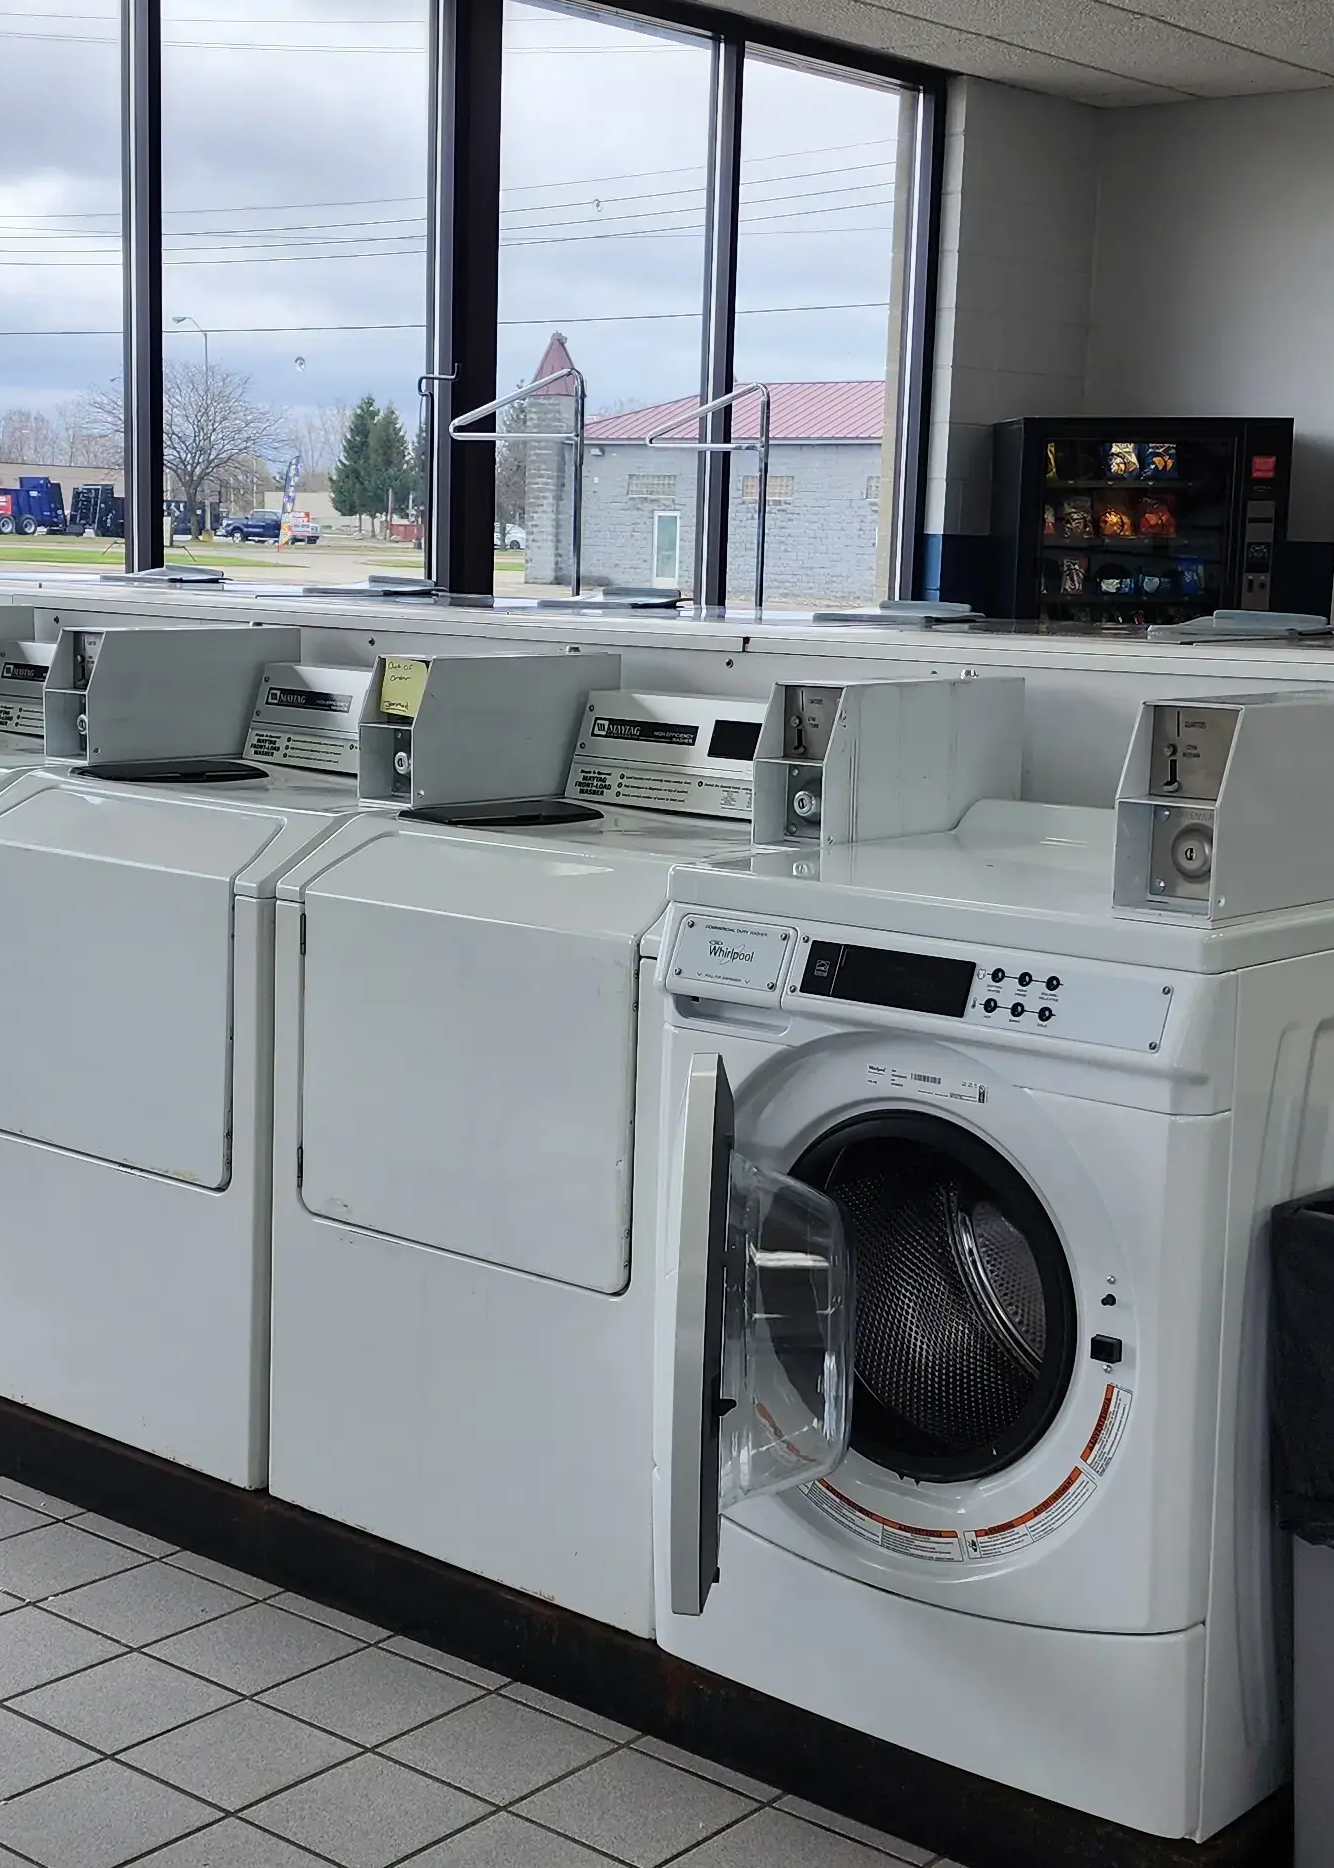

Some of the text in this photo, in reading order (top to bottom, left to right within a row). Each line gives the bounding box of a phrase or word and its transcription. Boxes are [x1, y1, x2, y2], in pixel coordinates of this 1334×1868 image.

[607, 724, 642, 736] MAYTAG
[665, 731, 695, 739] EFFICIENCY
[581, 774, 608, 783] MAYTAG
[574, 780, 612, 791] FRONT-LOAD
[578, 788, 605, 797] WASHER
[705, 924, 736, 933] COMMERCIAL
[708, 944, 755, 963] Whirlpool
